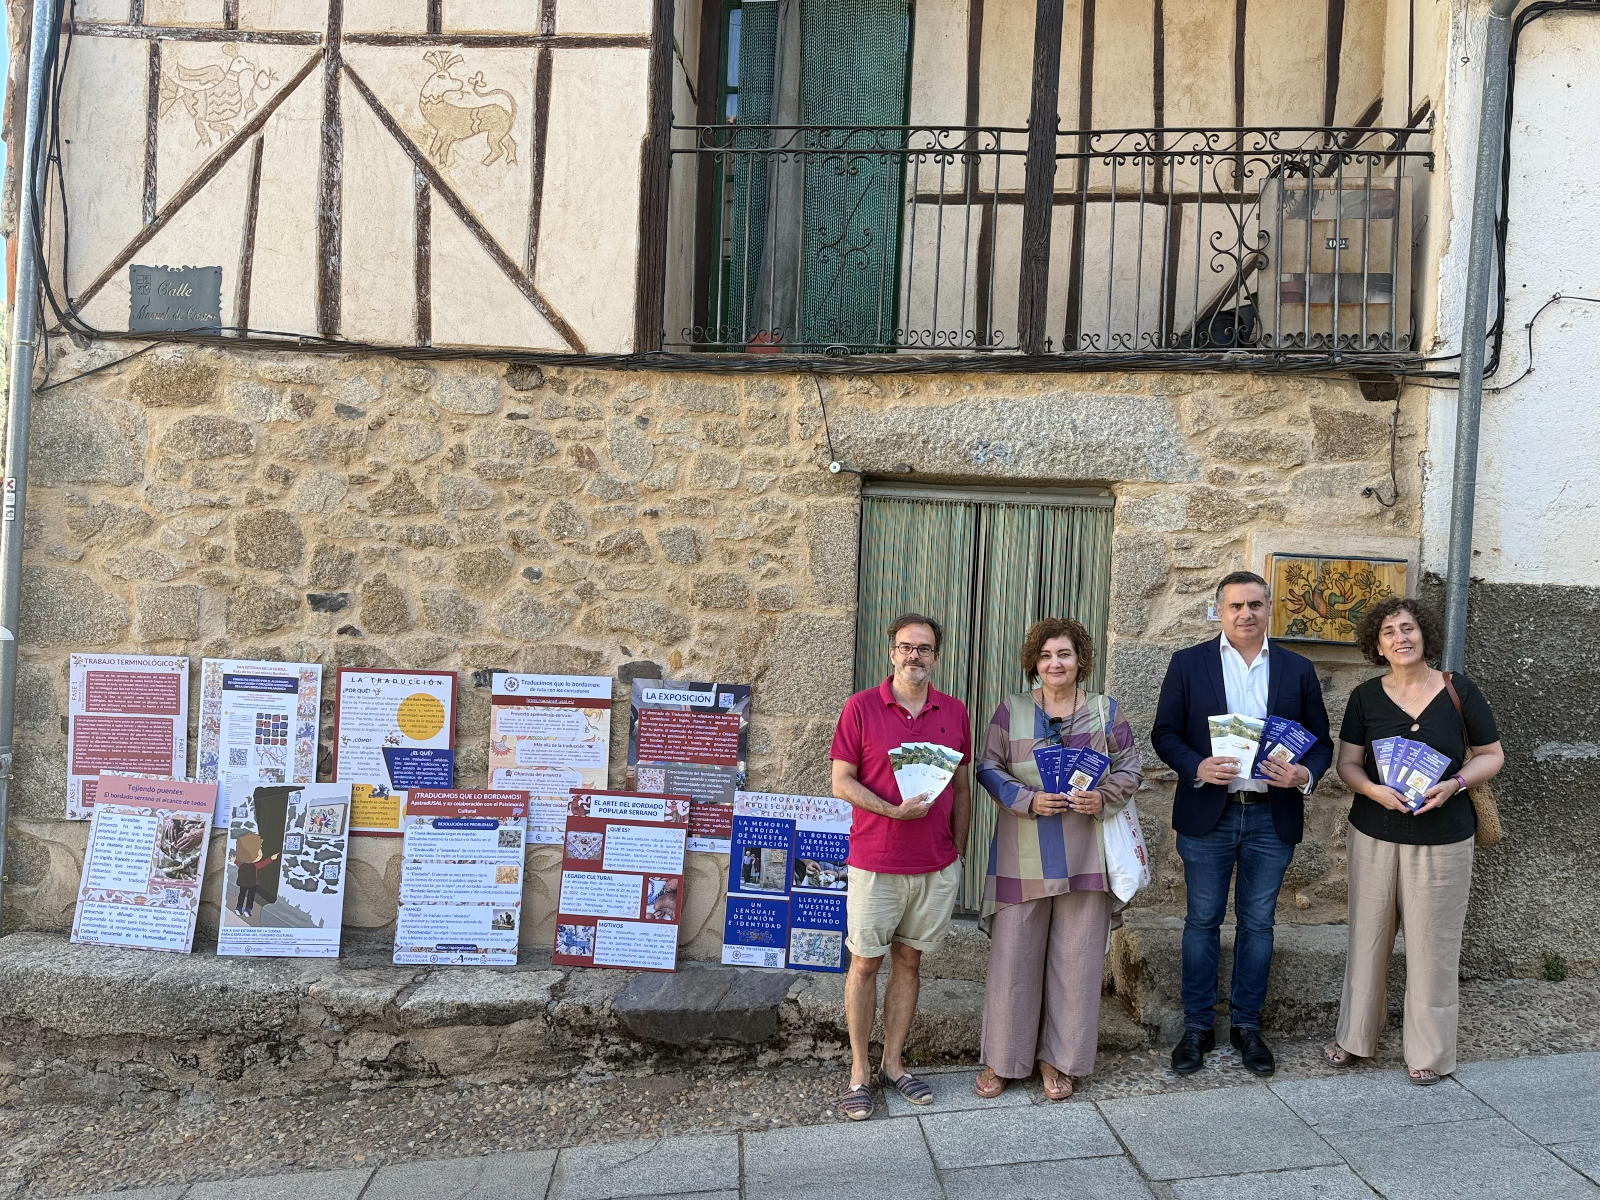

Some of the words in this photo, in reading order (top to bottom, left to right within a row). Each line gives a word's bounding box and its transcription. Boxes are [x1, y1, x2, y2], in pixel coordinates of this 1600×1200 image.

[158, 280, 192, 296] Calle
[133, 297, 170, 320] Manuel
[173, 306, 184, 320] de
[187, 305, 216, 321] Castro
[117, 658, 174, 666] TERMINOLÓGICO
[659, 693, 711, 703] EXPOSICIÓN
[128, 784, 155, 794] Tejiendo
[746, 802, 810, 812] REDESCUBRIR
[761, 810, 823, 820] RECONECTAR
[801, 851, 844, 859] ARTÍSTICO
[798, 897, 841, 905] LLEVANDO
[799, 904, 840, 912] NUESTRAS
[803, 909, 832, 917] RAÍCES
[736, 921, 781, 929] IDENTIDAD
